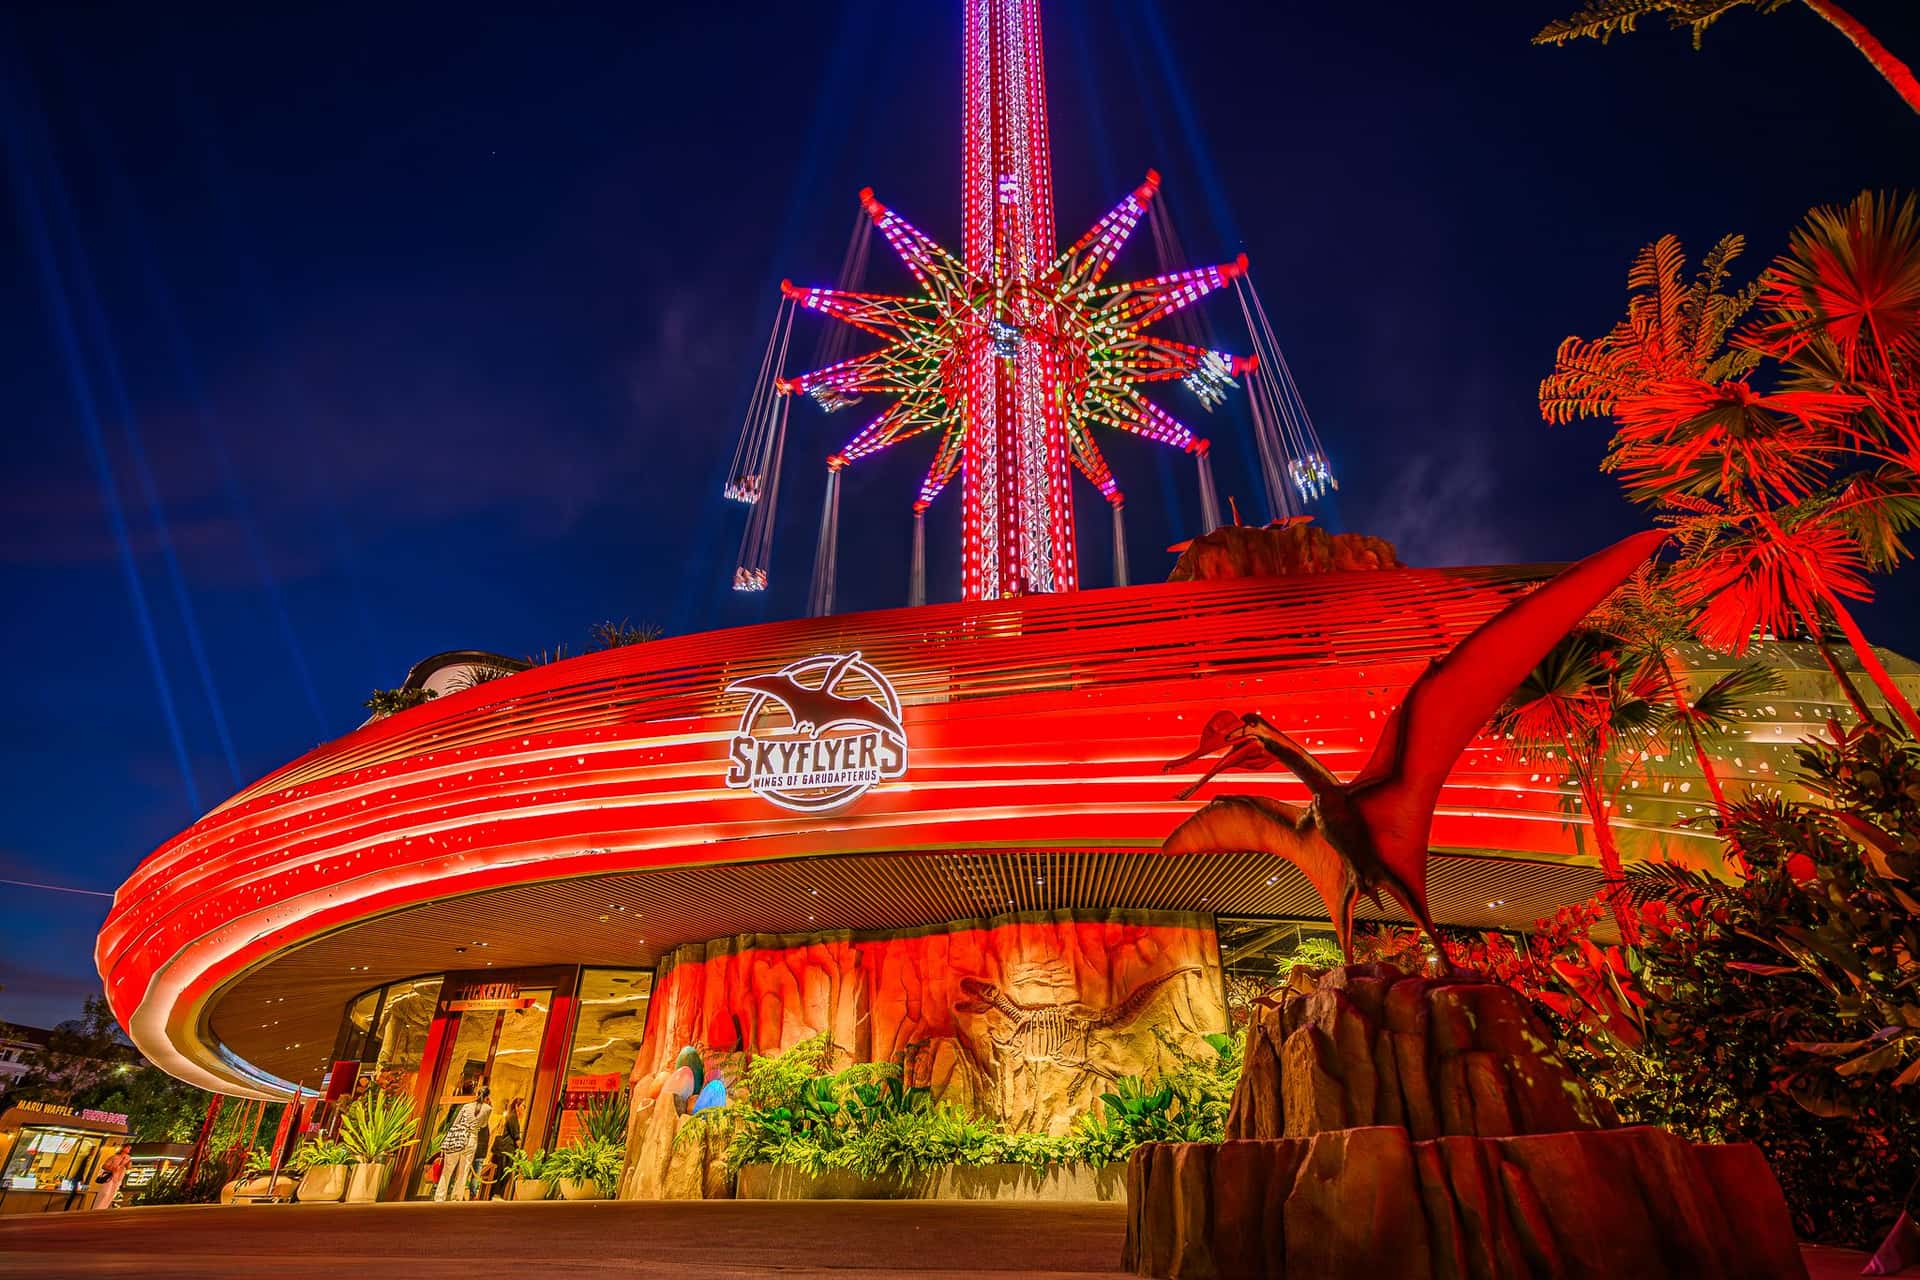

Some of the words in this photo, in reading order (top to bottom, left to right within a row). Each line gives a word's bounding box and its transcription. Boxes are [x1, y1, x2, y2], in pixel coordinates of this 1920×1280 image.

[726, 729, 907, 786] SKYFLYERS
[753, 776, 783, 788] WINGS
[786, 775, 798, 786] OF
[802, 769, 878, 785] GARUDAPTERUS
[17, 1100, 43, 1112] MARU
[44, 1103, 74, 1116] WAFFLE
